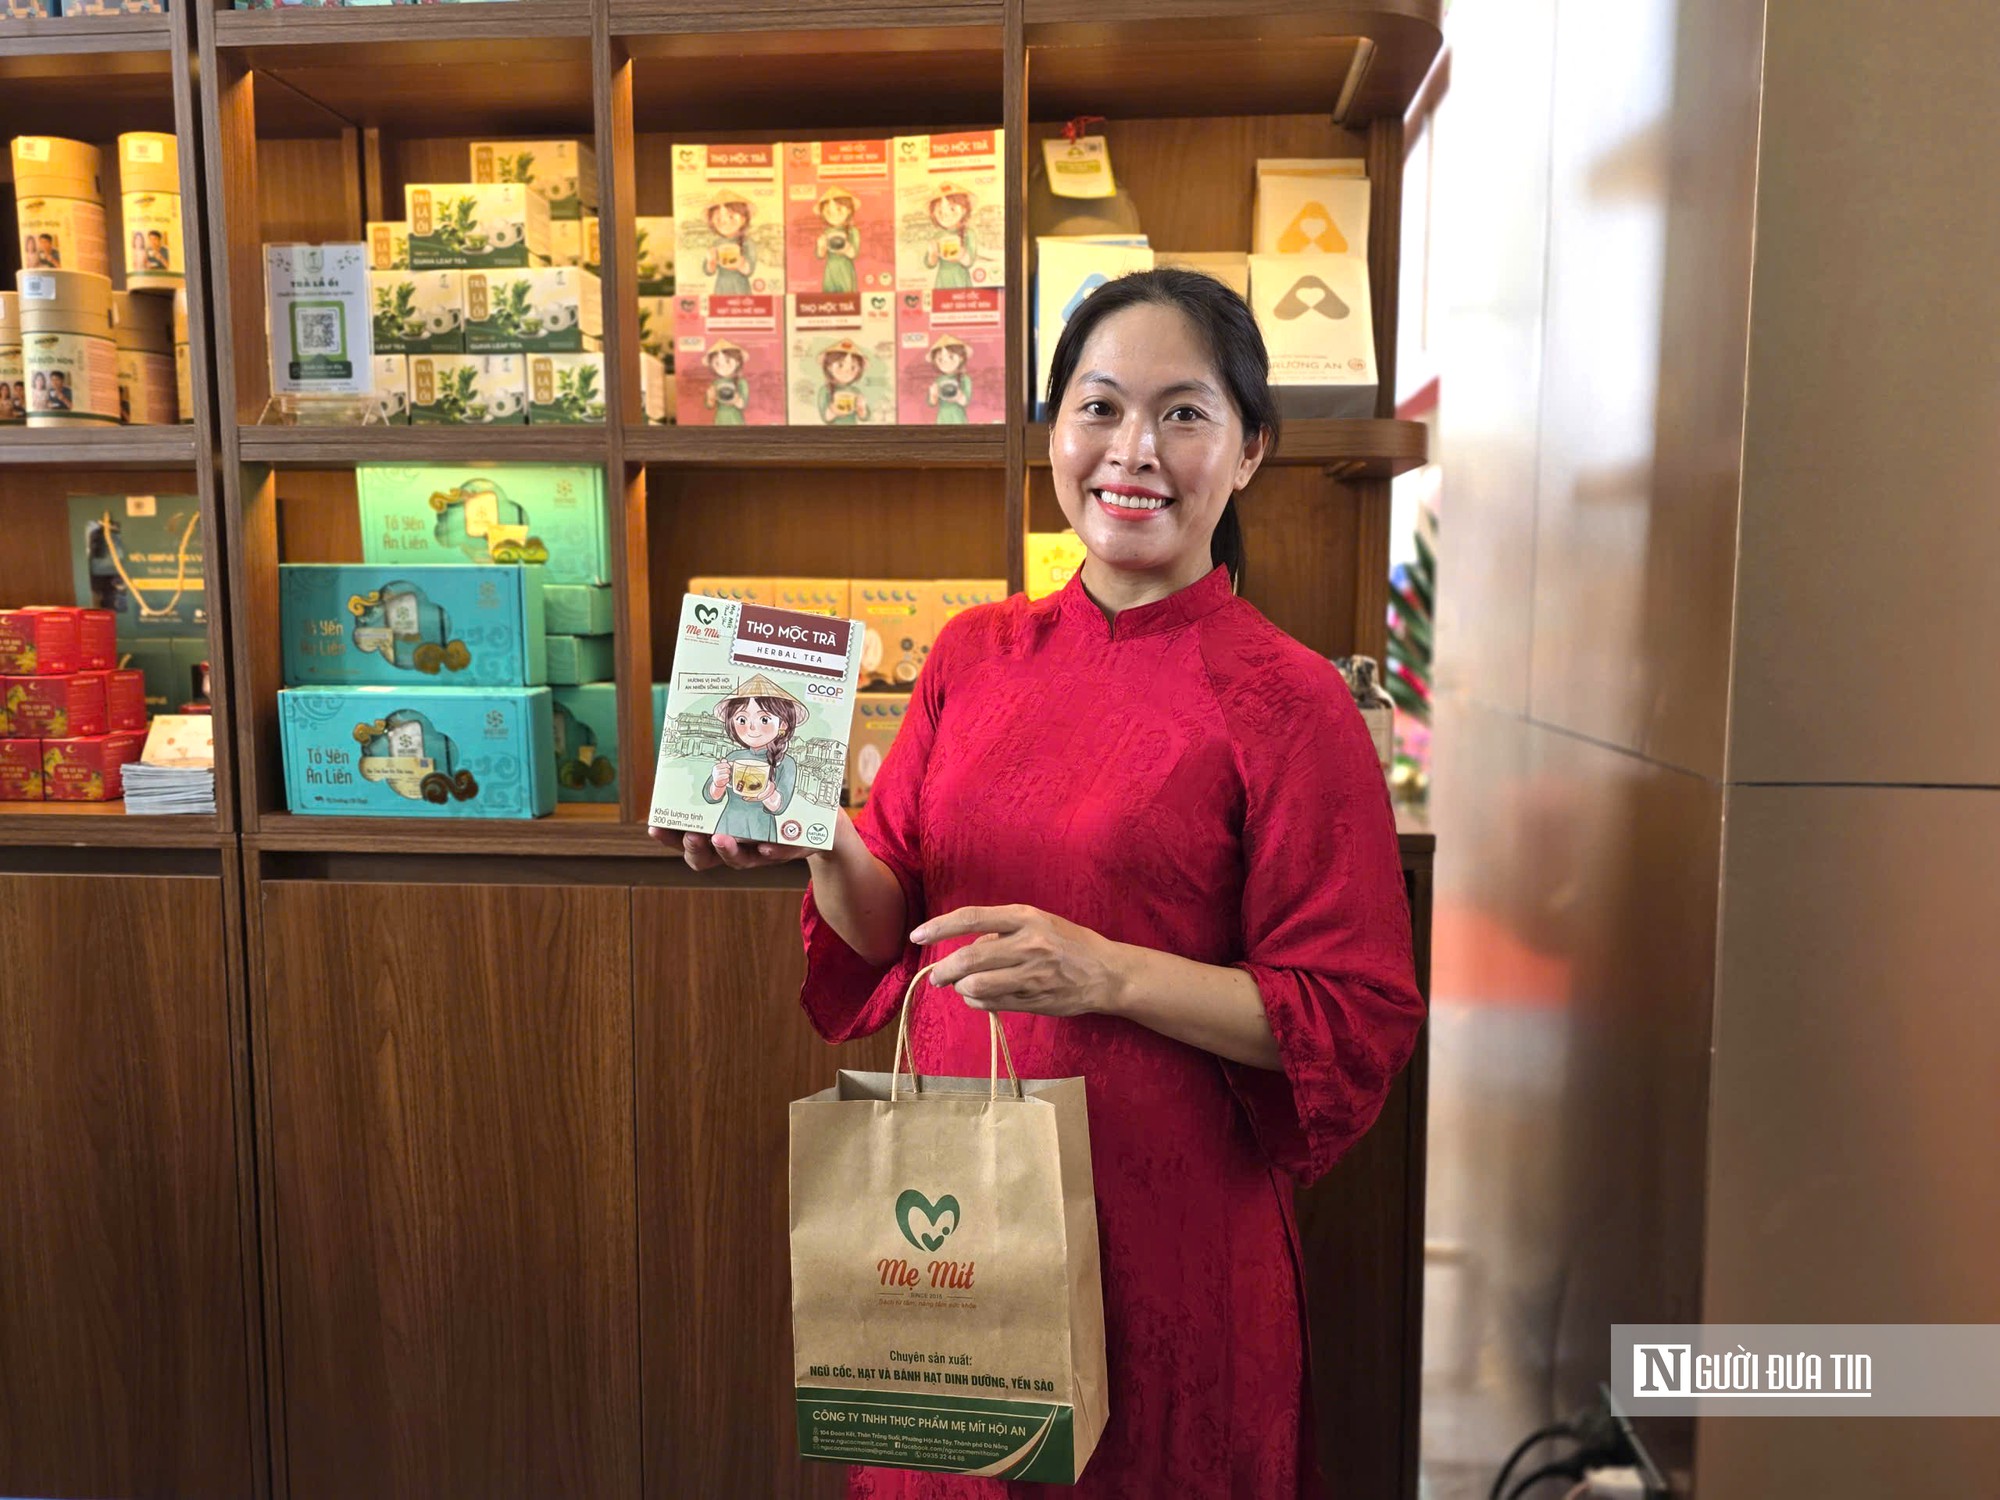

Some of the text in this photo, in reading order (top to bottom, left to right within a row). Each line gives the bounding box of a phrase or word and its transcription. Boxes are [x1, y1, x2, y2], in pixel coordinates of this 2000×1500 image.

[686, 624, 702, 636] Mẹ
[746, 620, 774, 639] THỌ
[778, 625, 809, 643] MỘC
[812, 630, 837, 647] TRÀ
[757, 646, 823, 663] HERBAL TEA
[808, 684, 844, 697] OCOP
[653, 815, 666, 824] 300
[666, 819, 682, 827] gam
[655, 807, 670, 817] Khối
[670, 809, 690, 821] lượng
[877, 1258, 975, 1291] Mẹ Mít
[889, 1350, 972, 1366] Chuyên sản xuất:
[809, 1363, 1054, 1392] NGŨ CỐC, HẠT VÀ BÁNH HẠT DINH DƯỠNG, YẾN SÀO
[812, 1408, 1026, 1437] CÔNG TY TNHH THỰC PHẨM MẸ MÍT HỘI AN
